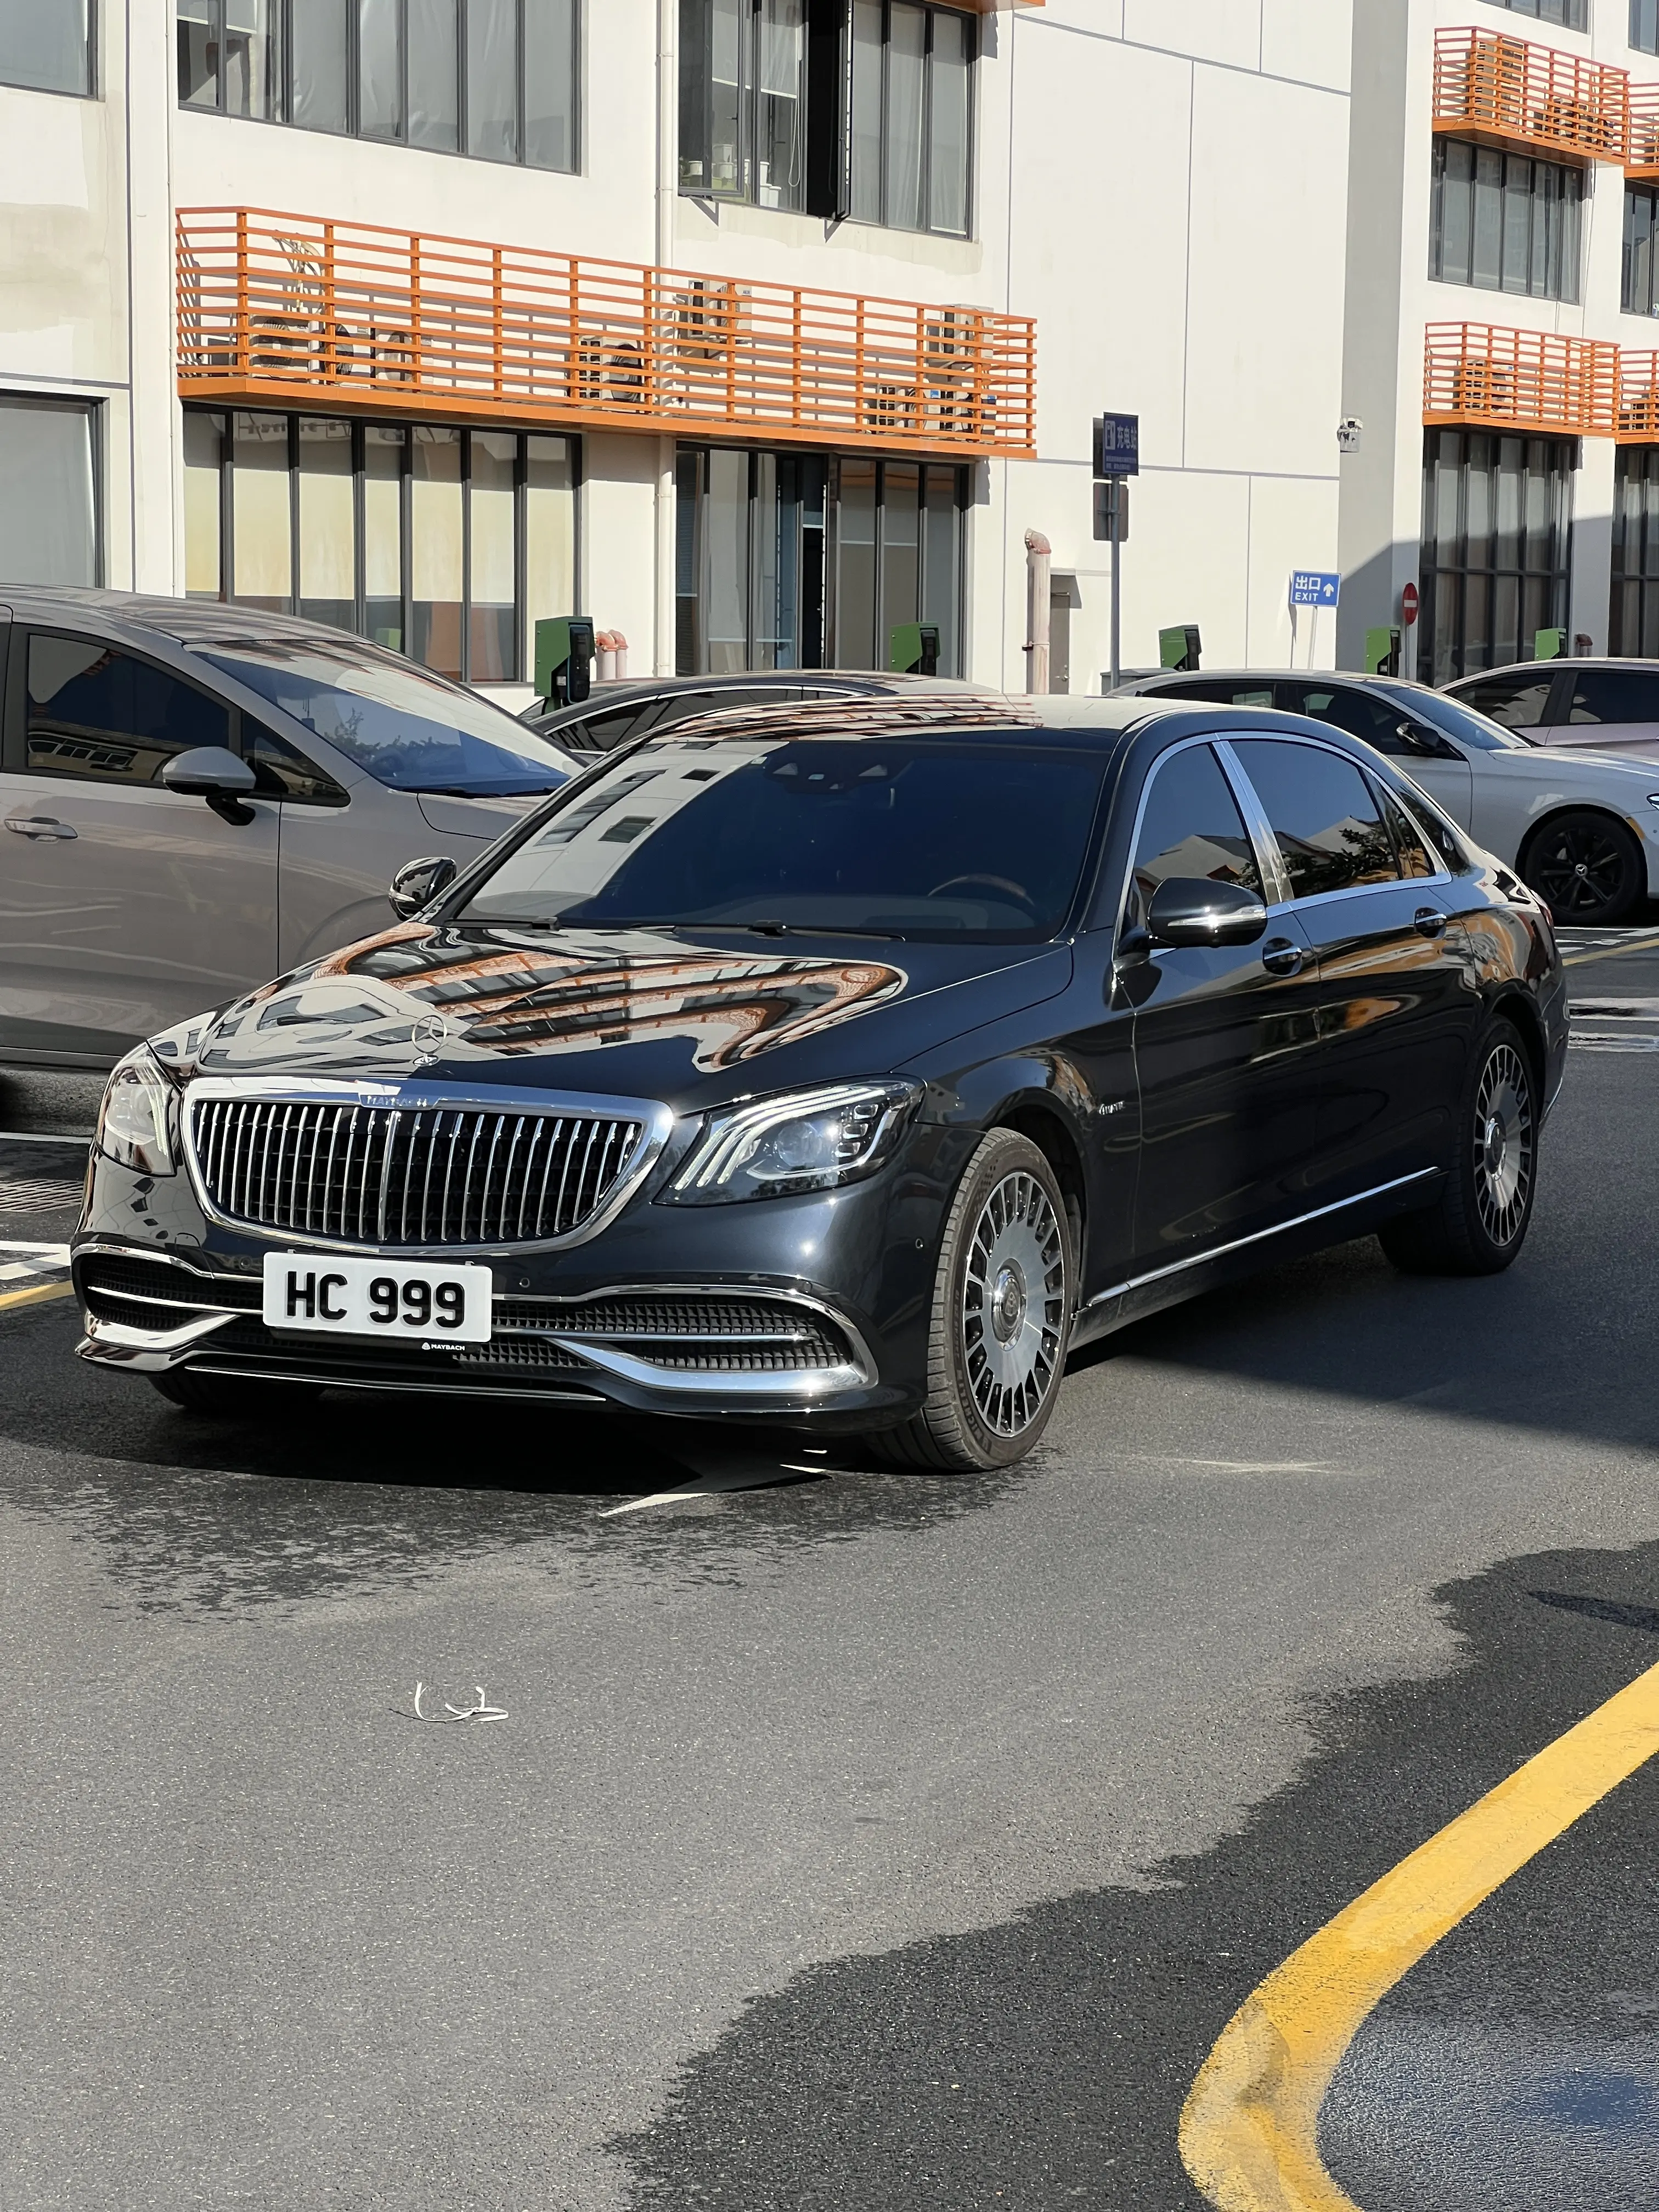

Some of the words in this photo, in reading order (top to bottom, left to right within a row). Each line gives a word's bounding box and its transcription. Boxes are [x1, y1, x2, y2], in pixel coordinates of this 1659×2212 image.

[1295, 575, 1321, 590] 出口
[1295, 592, 1318, 601] EXIT
[286, 1271, 348, 1320] HC
[369, 1277, 465, 1328] 999
